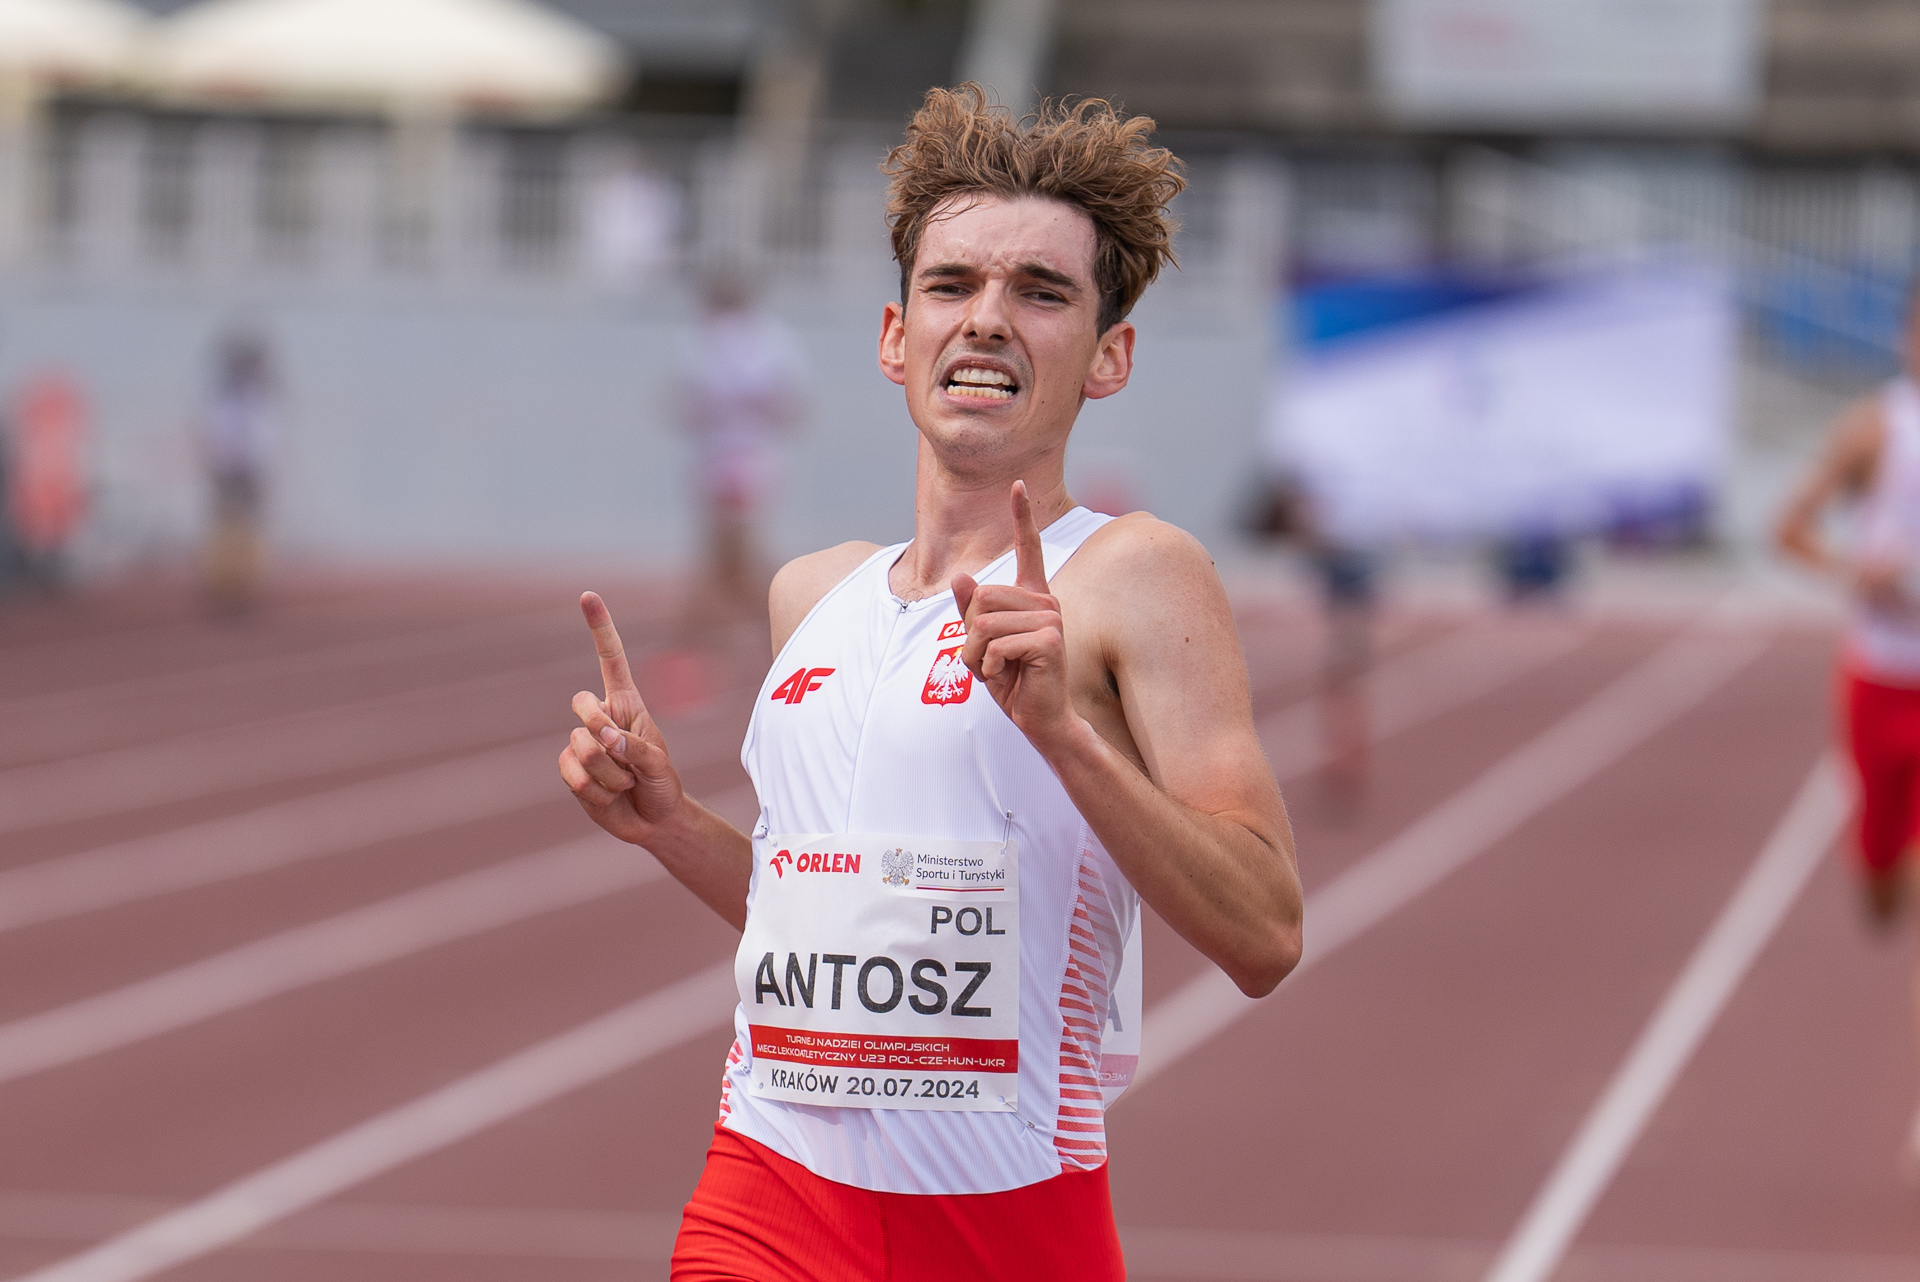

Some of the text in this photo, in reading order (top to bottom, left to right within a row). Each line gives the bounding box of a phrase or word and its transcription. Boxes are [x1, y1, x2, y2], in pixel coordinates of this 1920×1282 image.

[771, 667, 836, 704] 4F
[796, 853, 861, 873] ORLEN
[917, 854, 984, 866] Ministerstwo
[916, 868, 949, 879] Sportu
[959, 869, 1005, 882] Turystyki
[931, 906, 1006, 936] POL
[755, 952, 992, 1017] ANTOSZ
[786, 1034, 950, 1052] TURNEJ NADZIEI OLIMPIJSKICH
[756, 1044, 1006, 1067] MECZ LEKKOATLETYCZNY U23 POL-CZE-HUN-UKR
[771, 1068, 980, 1099] KRAKÓW 20.07.2024
